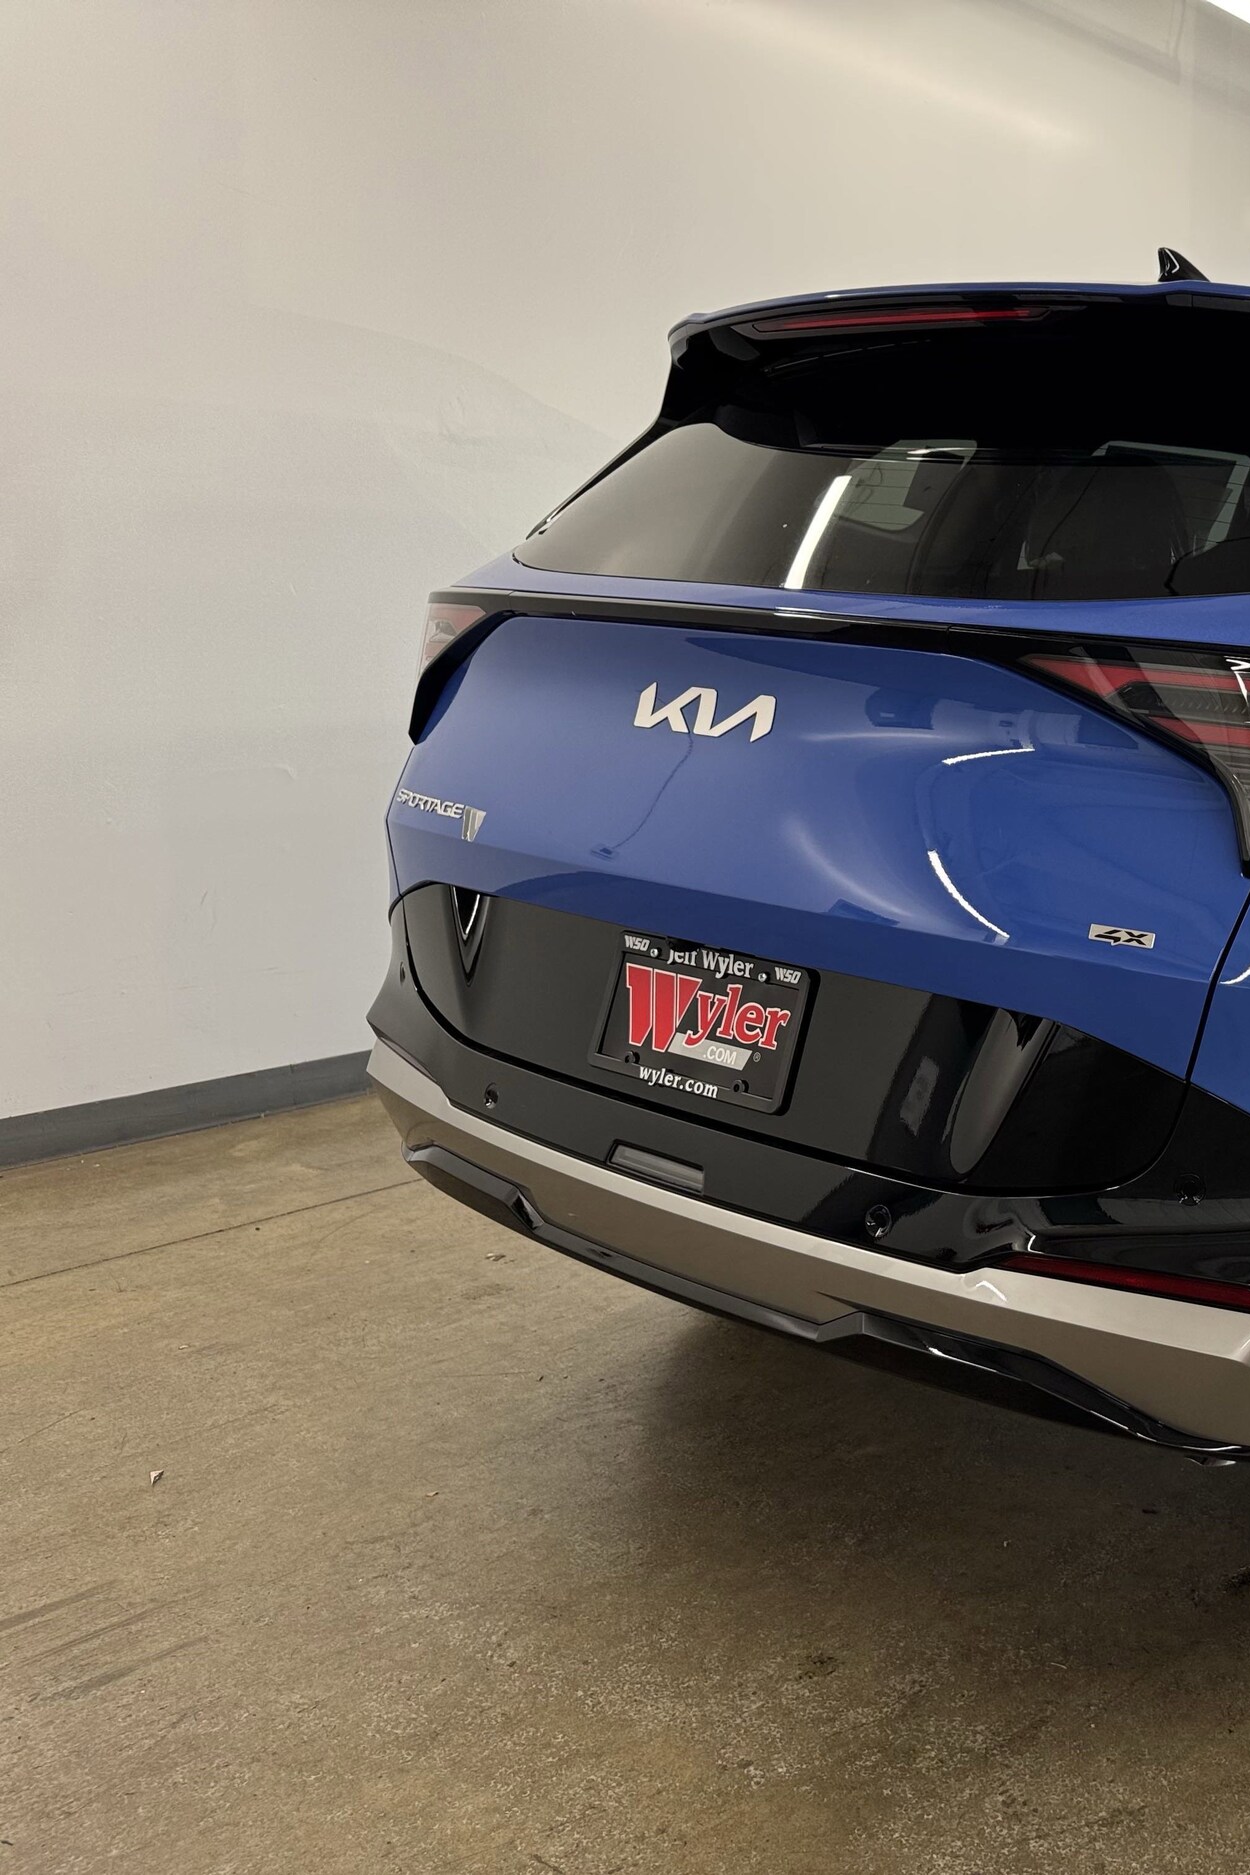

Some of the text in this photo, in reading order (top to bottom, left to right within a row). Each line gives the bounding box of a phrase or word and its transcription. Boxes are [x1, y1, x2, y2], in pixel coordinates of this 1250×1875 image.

[633, 682, 777, 743] KIA
[397, 788, 464, 818] SPORTAGE
[701, 949, 755, 979] Wyler
[625, 962, 792, 1053] Wyler
[703, 1045, 738, 1066] .COM
[639, 1065, 719, 1099] wyler.com
